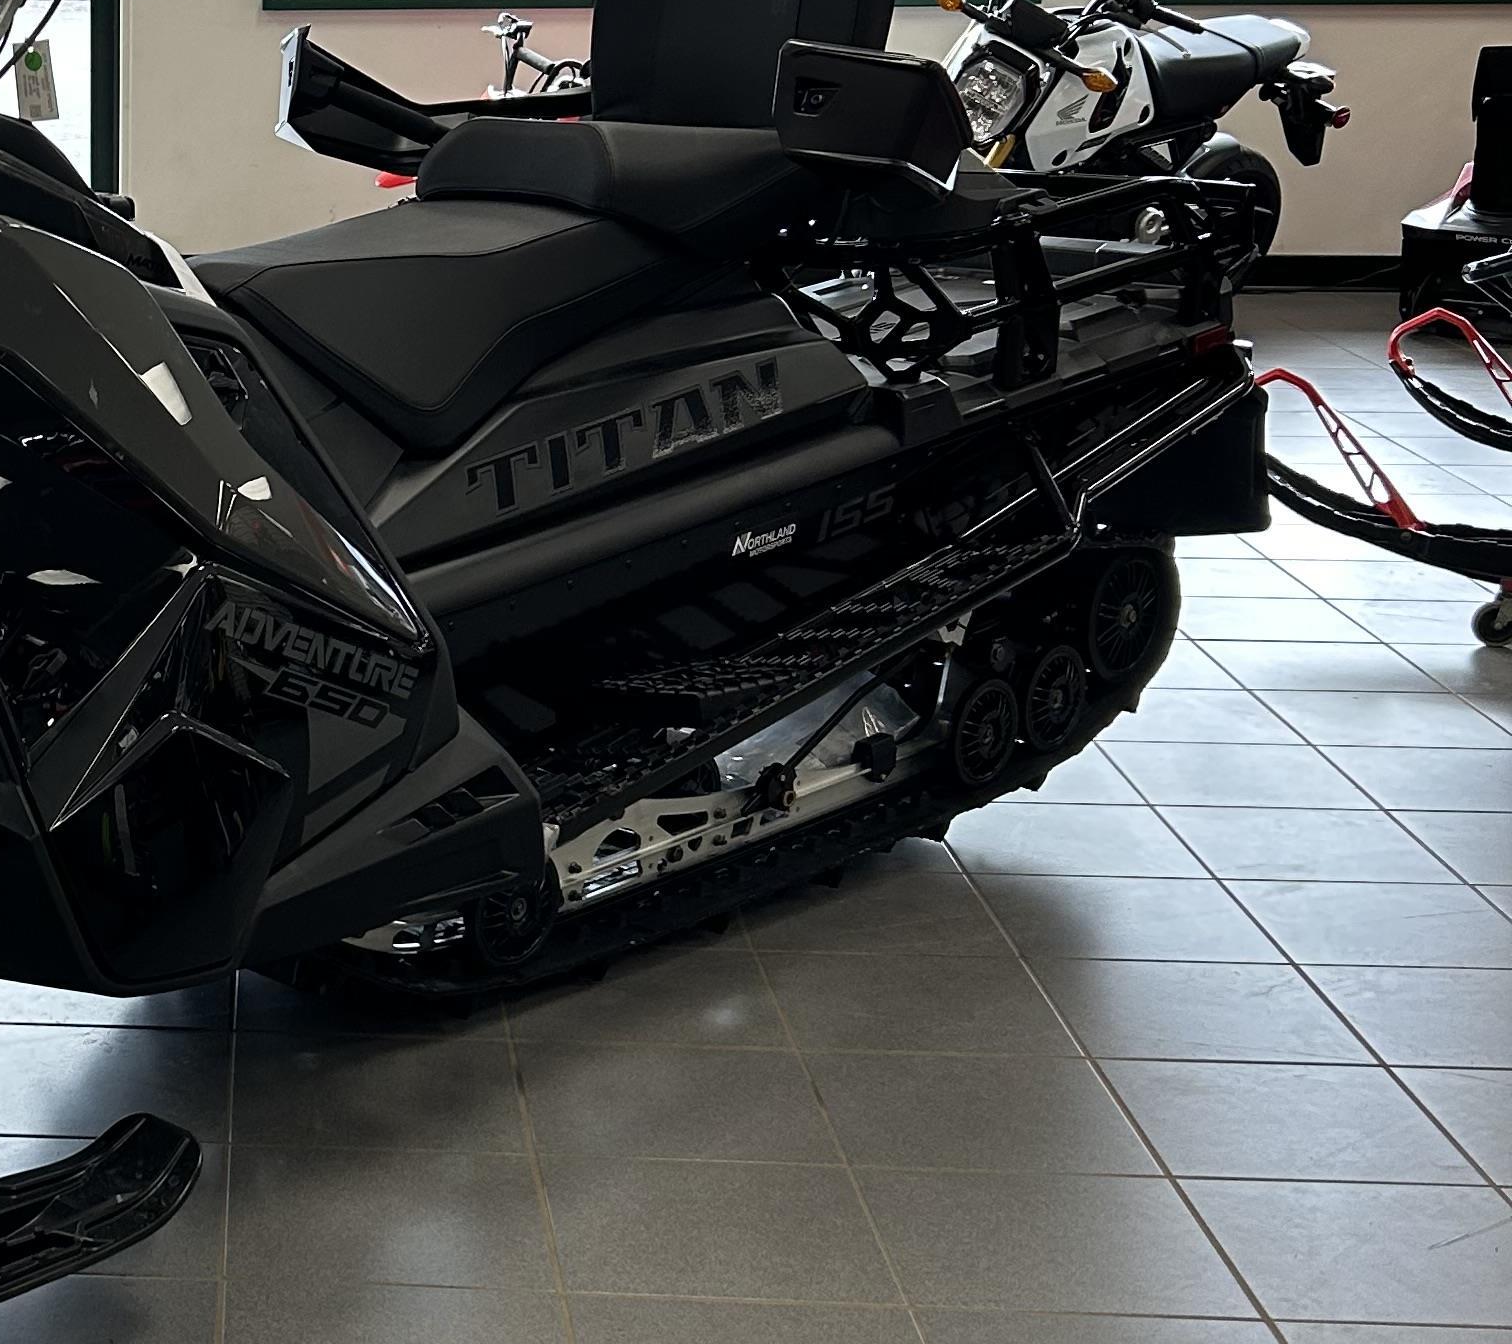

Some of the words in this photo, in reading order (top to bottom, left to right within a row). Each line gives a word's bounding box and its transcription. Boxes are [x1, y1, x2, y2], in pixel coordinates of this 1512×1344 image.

[1055, 117, 1087, 126] HONDA
[1455, 233, 1498, 244] POWER
[465, 356, 784, 519] TITAN
[731, 523, 797, 557] NORTHLAND
[816, 482, 897, 544] 155
[204, 601, 420, 700] ADVENTURE
[266, 667, 390, 729] 650
